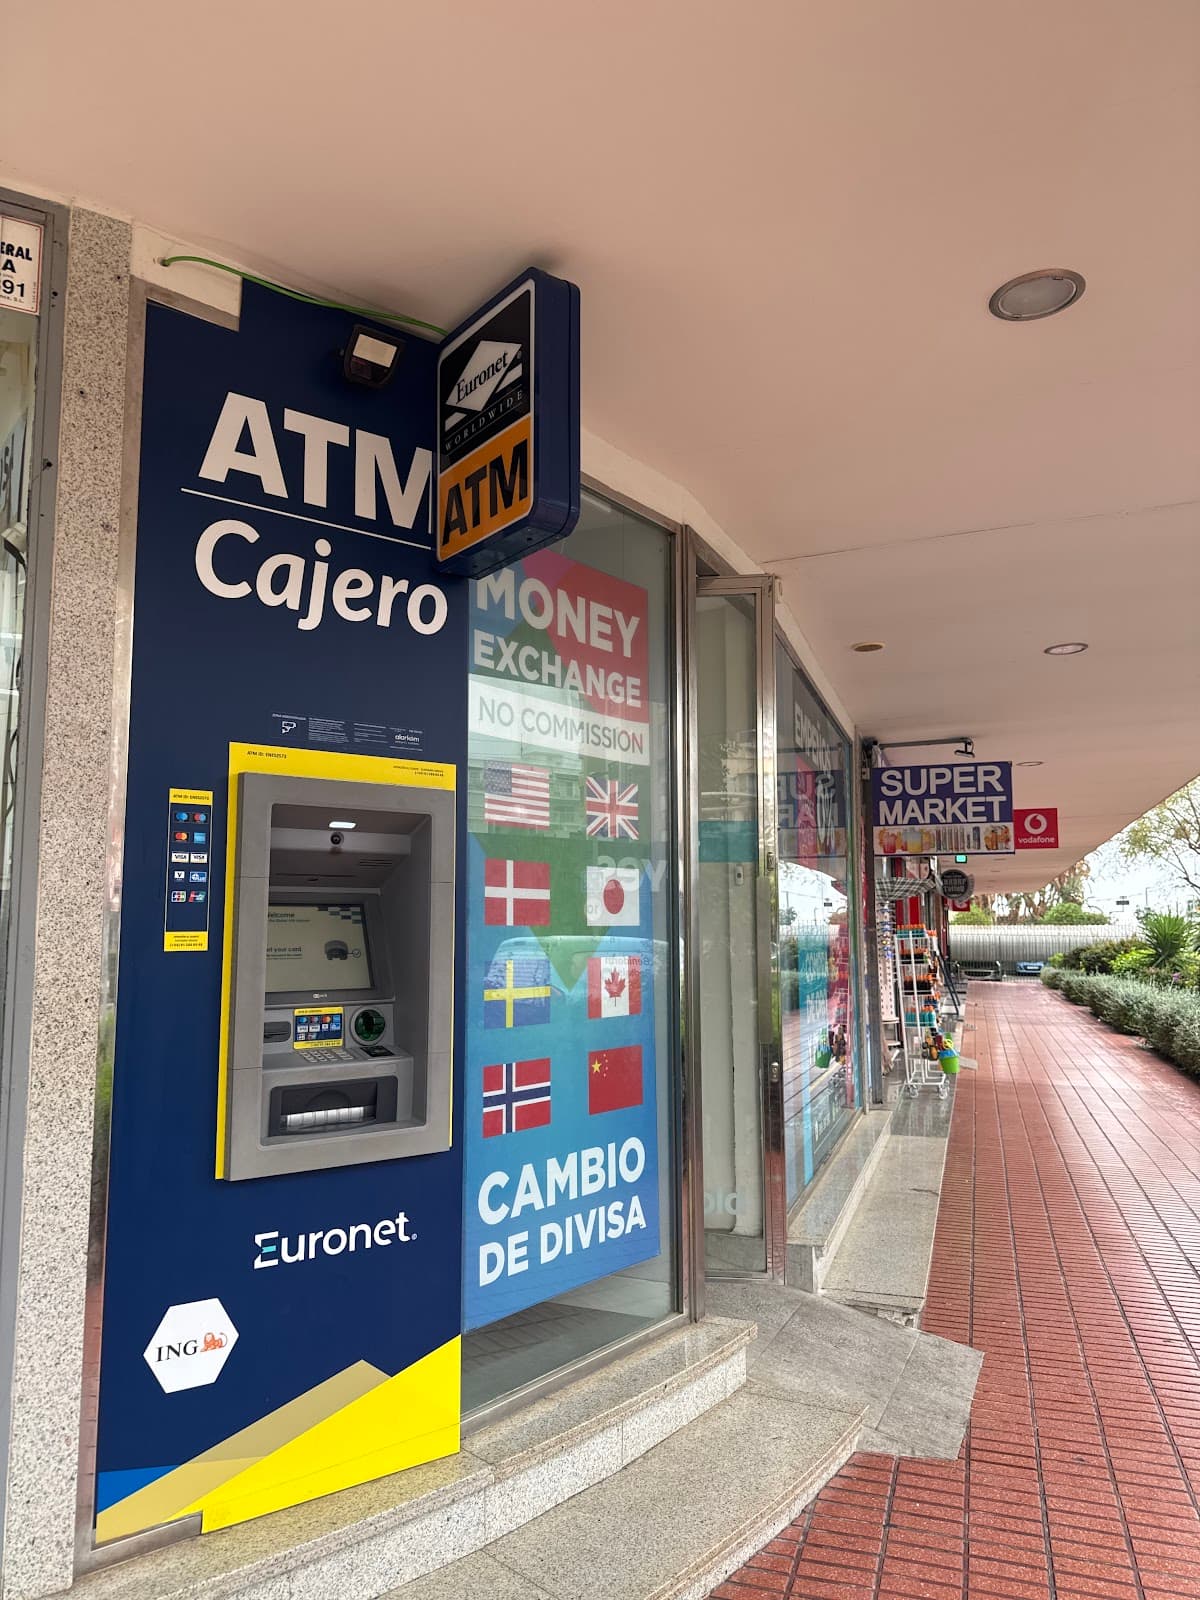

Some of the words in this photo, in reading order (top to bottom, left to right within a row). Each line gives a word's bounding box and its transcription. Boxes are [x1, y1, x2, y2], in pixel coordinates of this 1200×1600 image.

[0, 279, 25, 298] 91
[455, 351, 508, 405] Euronet
[445, 389, 523, 451] WORLDWIDE
[198, 391, 433, 535] ATM
[442, 438, 528, 547] ATM
[195, 519, 448, 636] Cajero
[476, 566, 640, 658] MONEY
[473, 628, 641, 708] EXCHANGE
[479, 696, 514, 727] NO
[521, 707, 643, 754] COMMISSION
[879, 795, 1007, 825] MARKET
[880, 765, 1004, 797] SUPER
[1017, 835, 1056, 845] vodafone
[477, 1136, 646, 1226] CAMBIO
[254, 1211, 411, 1269] Euronet
[479, 1230, 529, 1287] DE
[540, 1195, 647, 1265] DIVISA
[155, 1339, 199, 1363] ING
